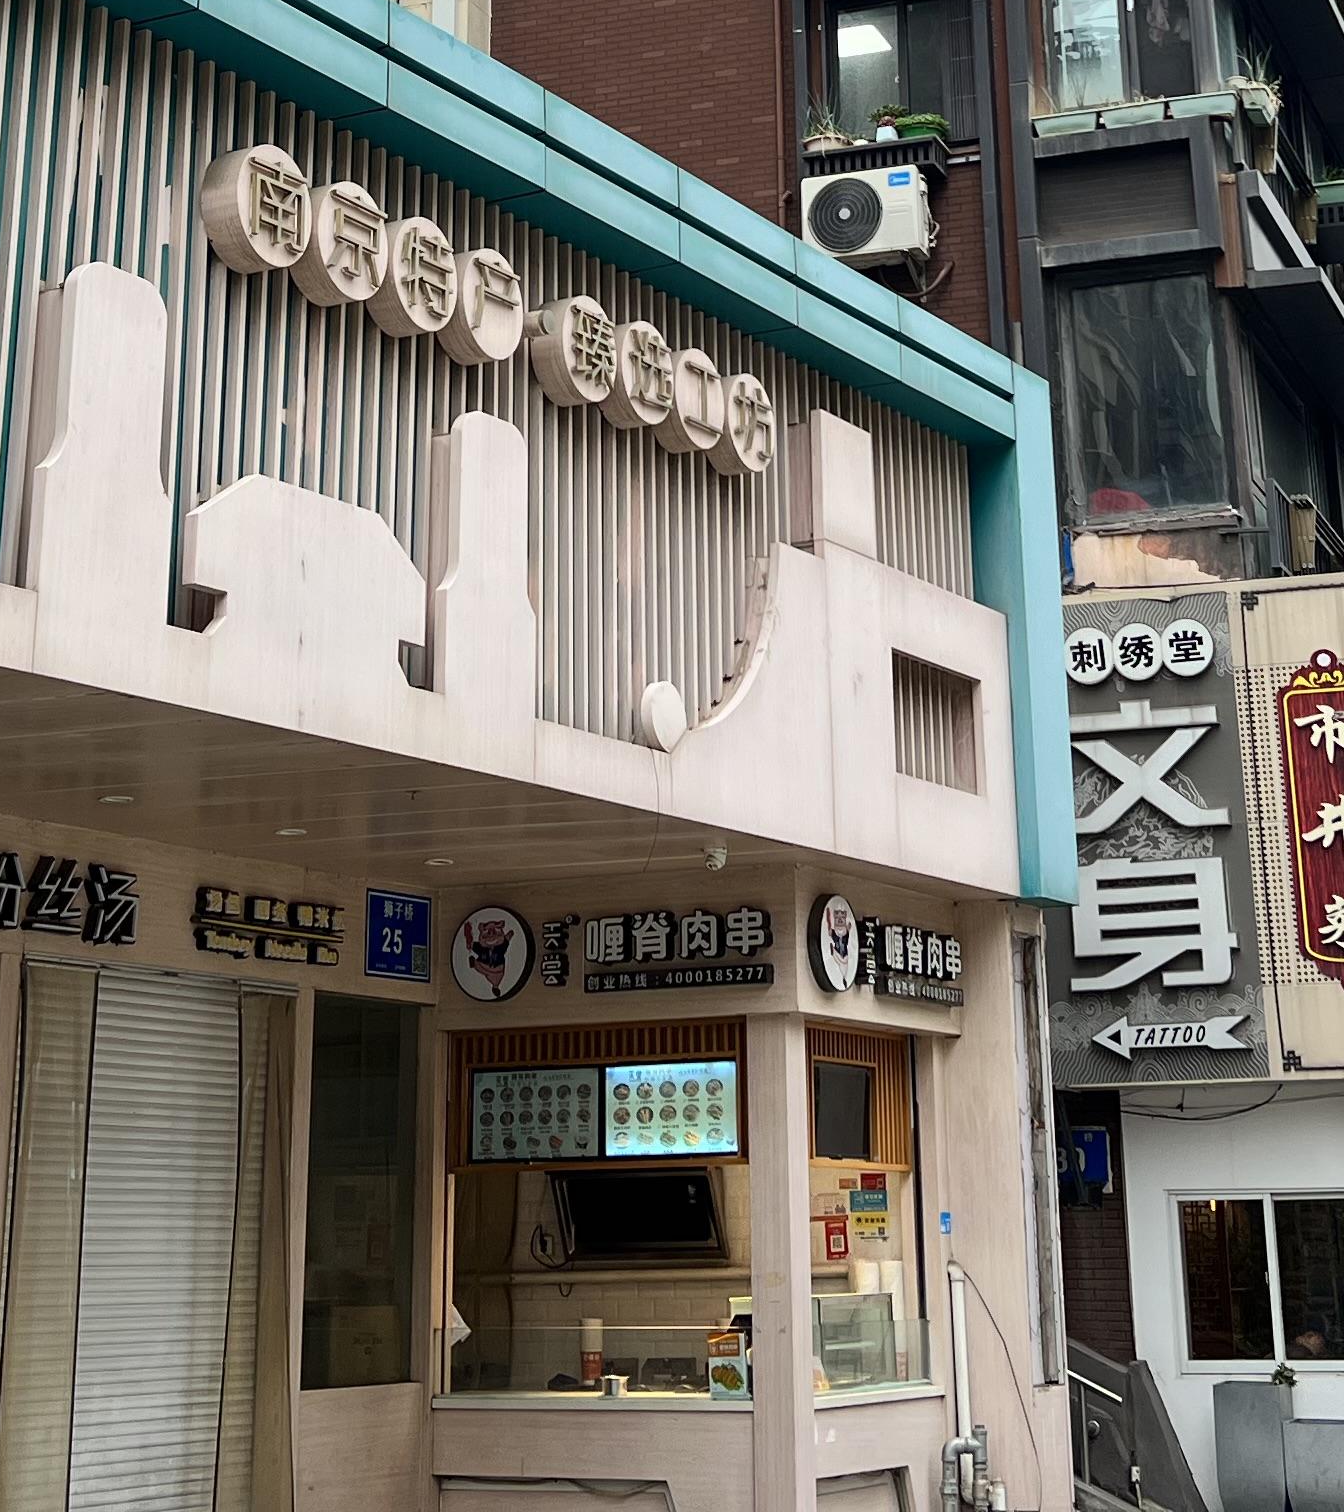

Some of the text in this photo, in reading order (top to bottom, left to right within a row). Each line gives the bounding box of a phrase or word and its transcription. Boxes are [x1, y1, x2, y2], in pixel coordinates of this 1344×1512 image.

[248, 155, 523, 330] 南京特产
[1069, 629, 1206, 674] 刺绣堂
[1070, 698, 1240, 993] 文身
[381, 927, 403, 954] 25
[1133, 1024, 1207, 1046] TATTOO
